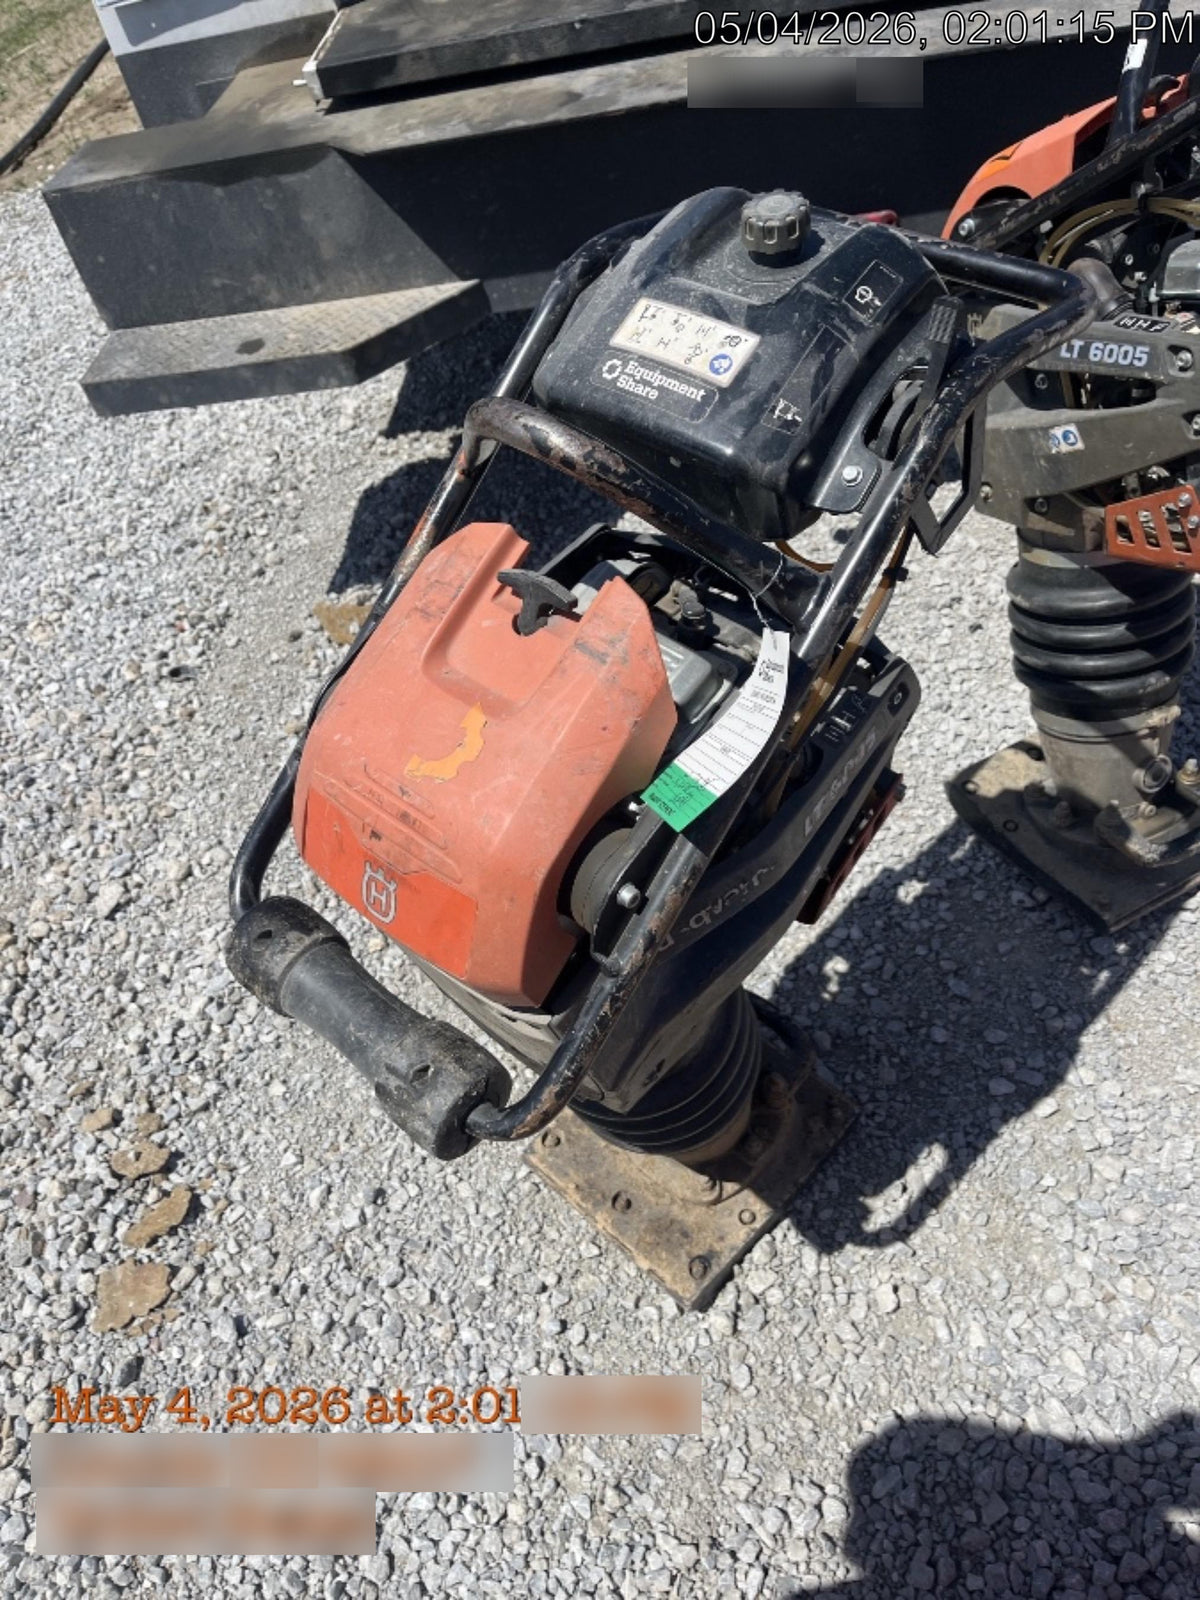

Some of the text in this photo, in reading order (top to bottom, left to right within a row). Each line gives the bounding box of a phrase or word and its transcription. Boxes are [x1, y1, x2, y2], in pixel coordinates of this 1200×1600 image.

[1060, 339, 1150, 367] LT 6005
[616, 375, 659, 400] Share
[624, 360, 706, 402] Equipment
